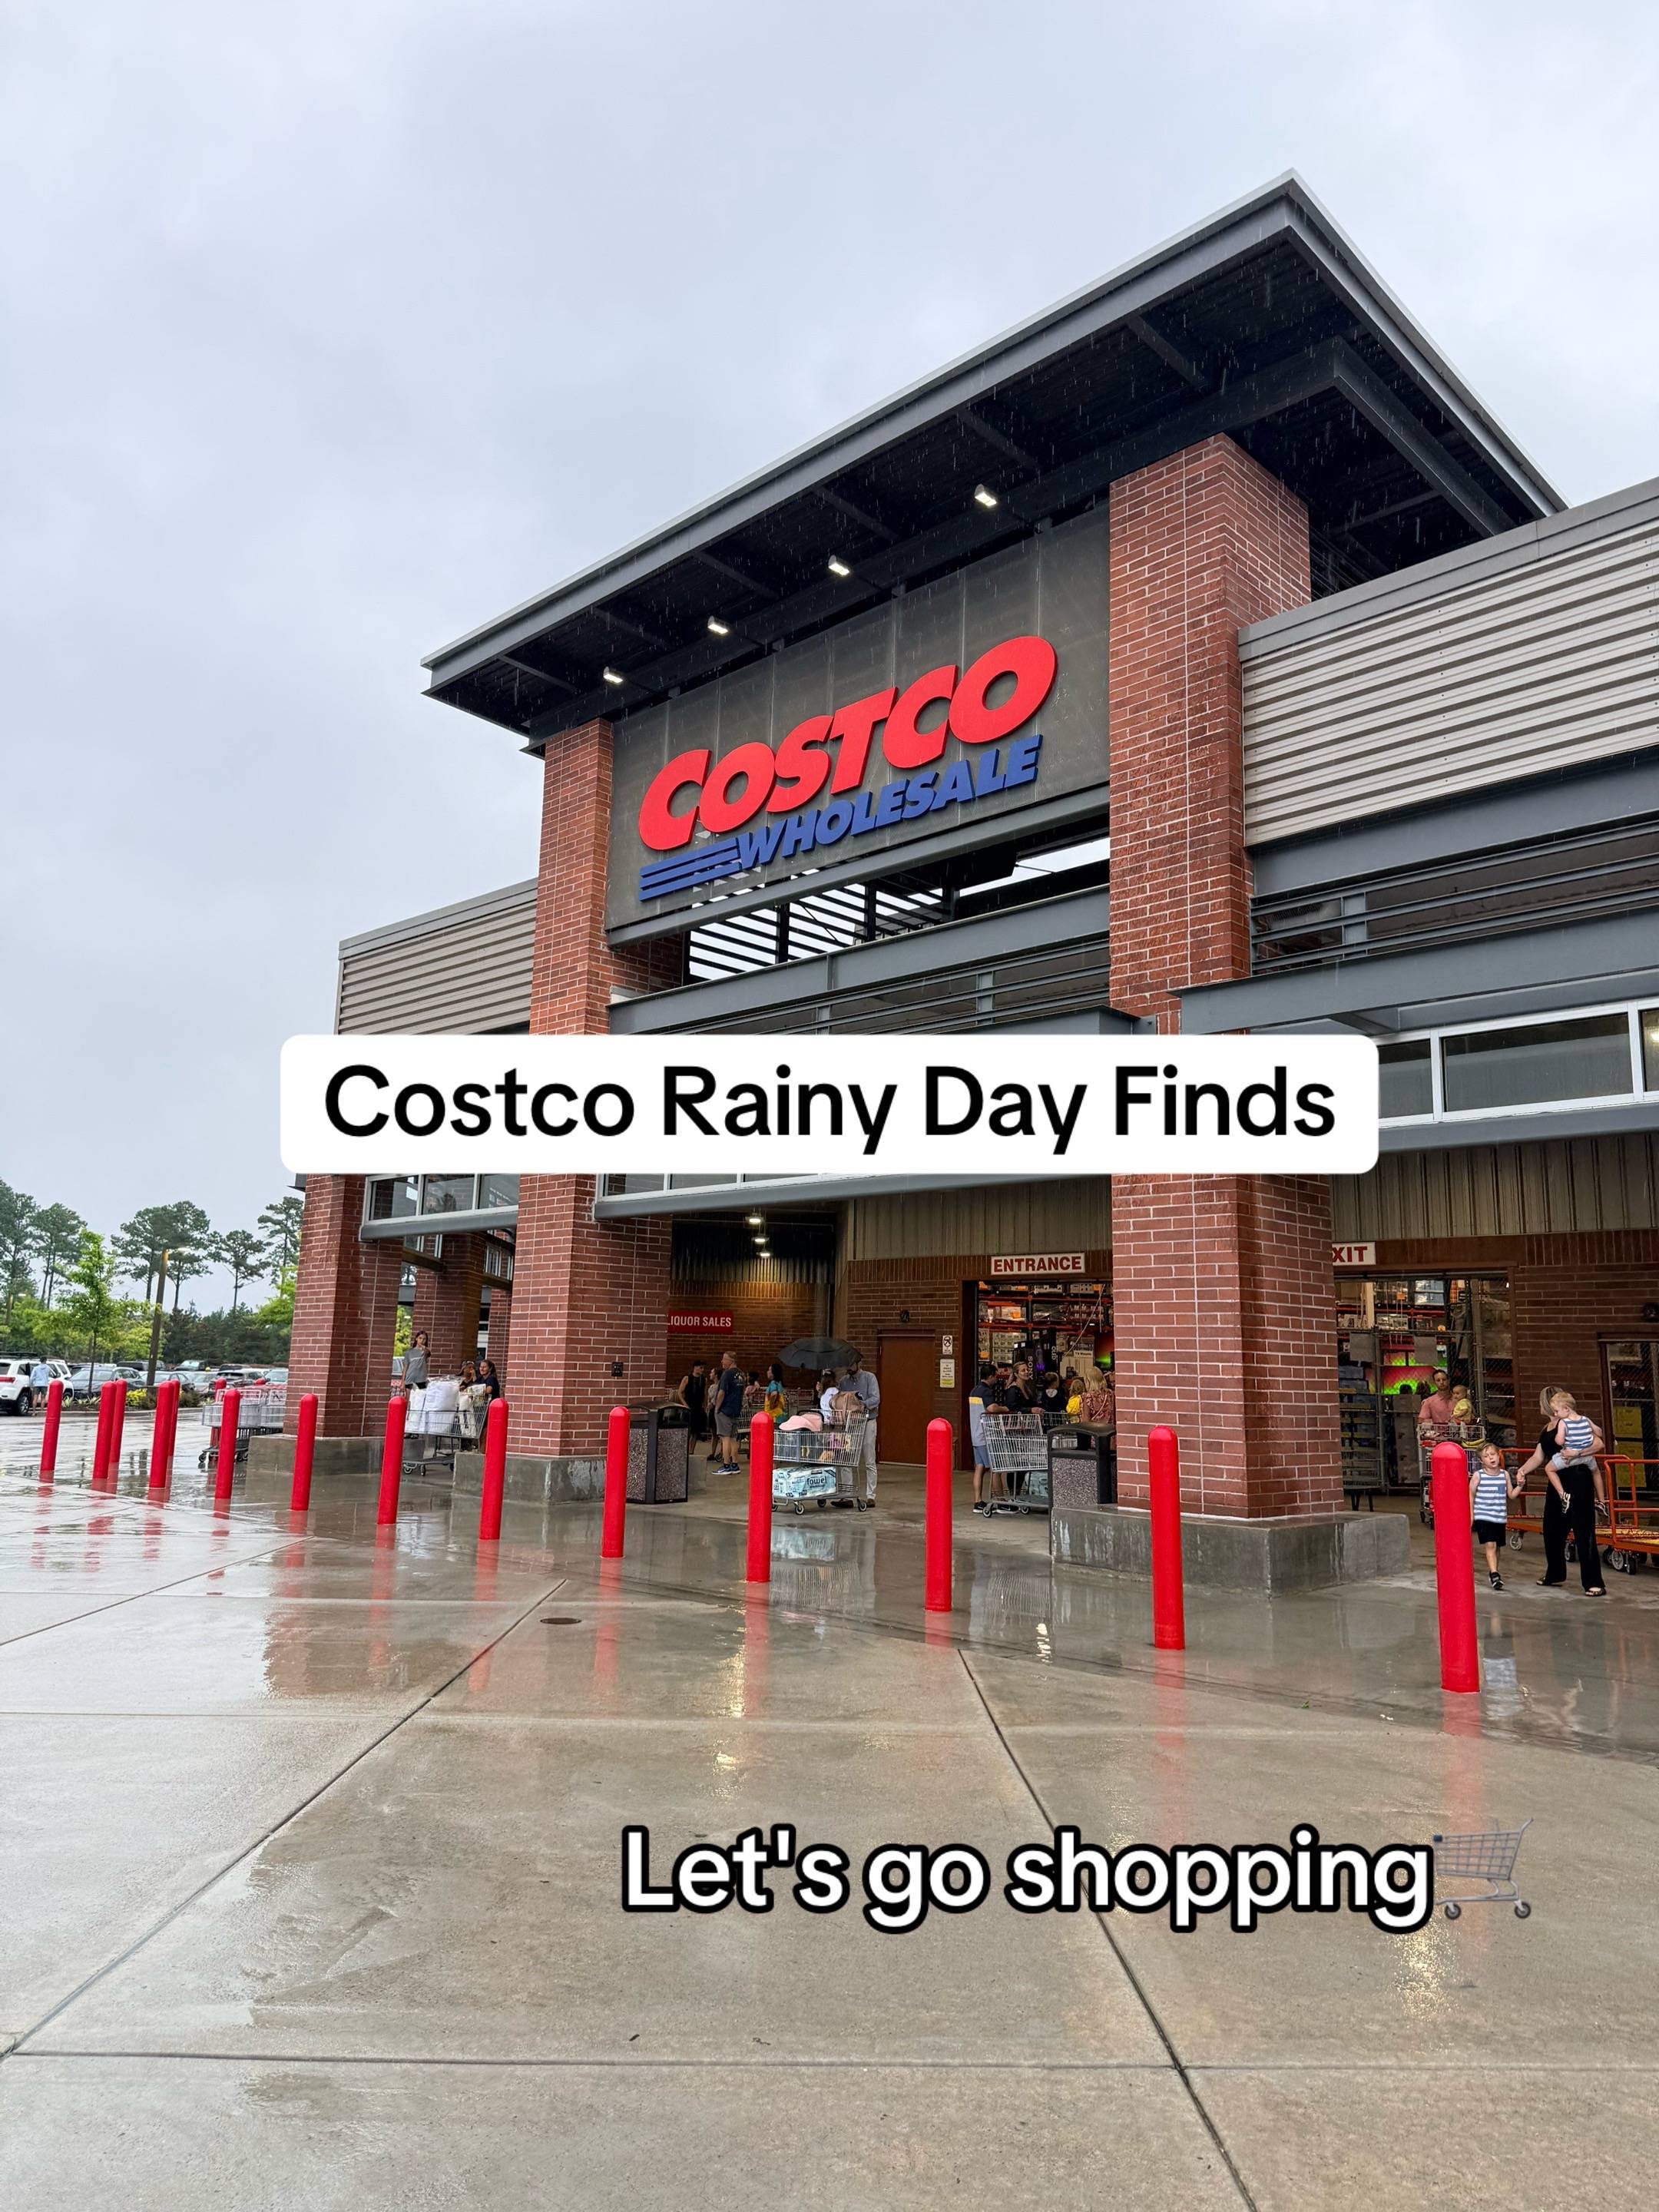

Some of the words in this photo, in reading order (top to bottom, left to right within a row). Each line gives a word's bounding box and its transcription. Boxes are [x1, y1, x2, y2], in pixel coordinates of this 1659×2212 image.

[638, 636, 1058, 851] COSTCO
[736, 734, 1043, 869] WHOLESALE
[1333, 1246, 1368, 1263] XIT
[994, 1256, 1081, 1272] ENTRANCE
[667, 1316, 700, 1326] IQUOR
[702, 1316, 731, 1327] SALES
